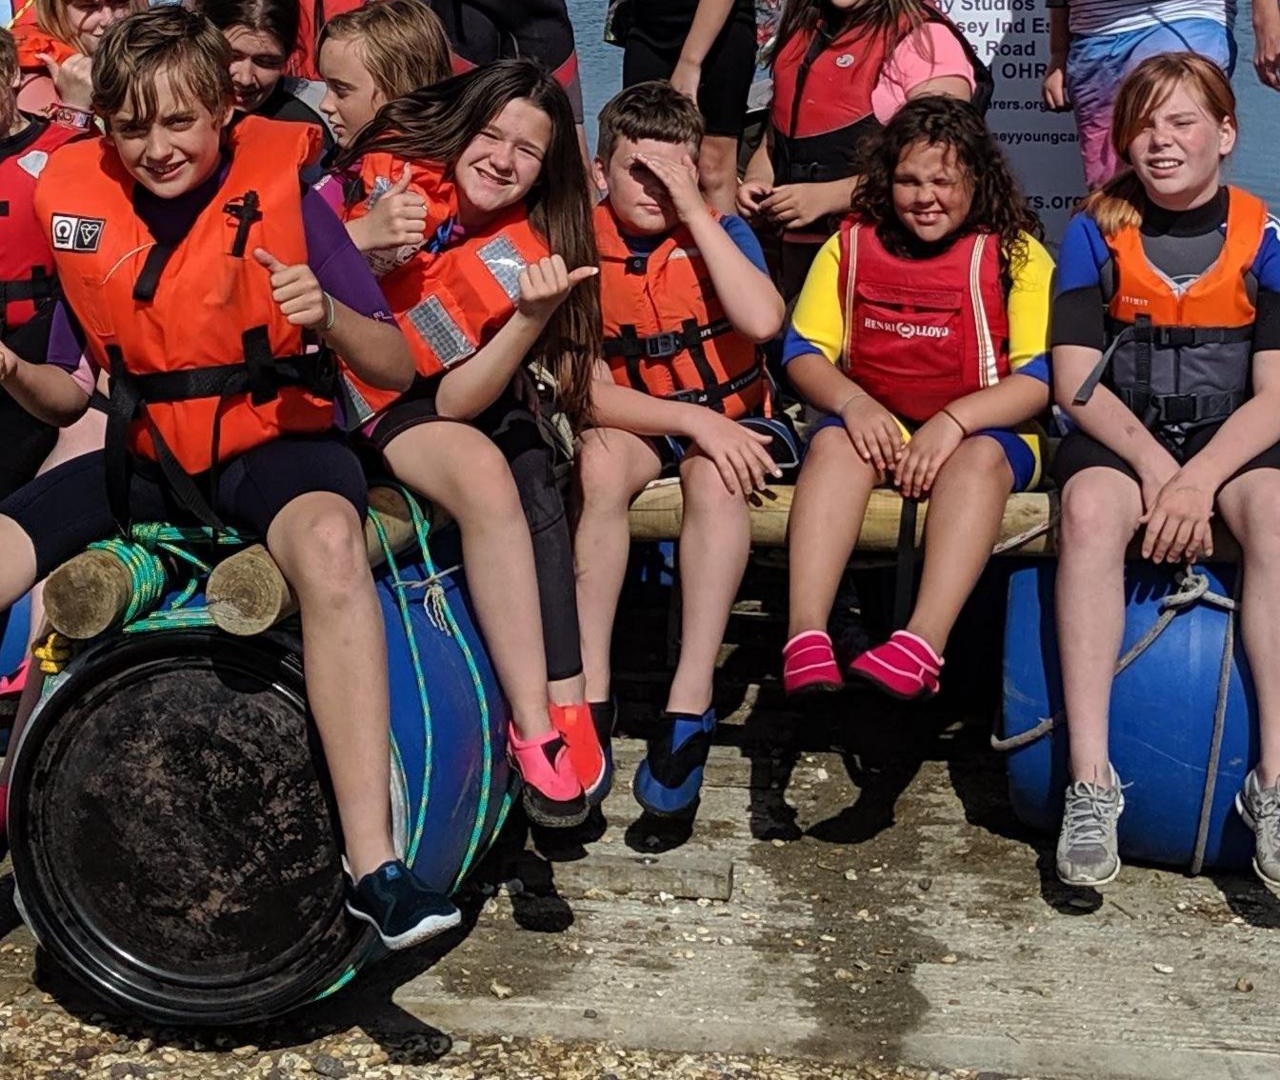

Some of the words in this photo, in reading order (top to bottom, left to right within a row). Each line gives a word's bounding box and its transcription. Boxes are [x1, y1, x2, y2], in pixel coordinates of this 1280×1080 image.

[995, 18, 1026, 34] Ind
[986, 40, 1036, 57] Road
[864, 317, 896, 333] HENRI
